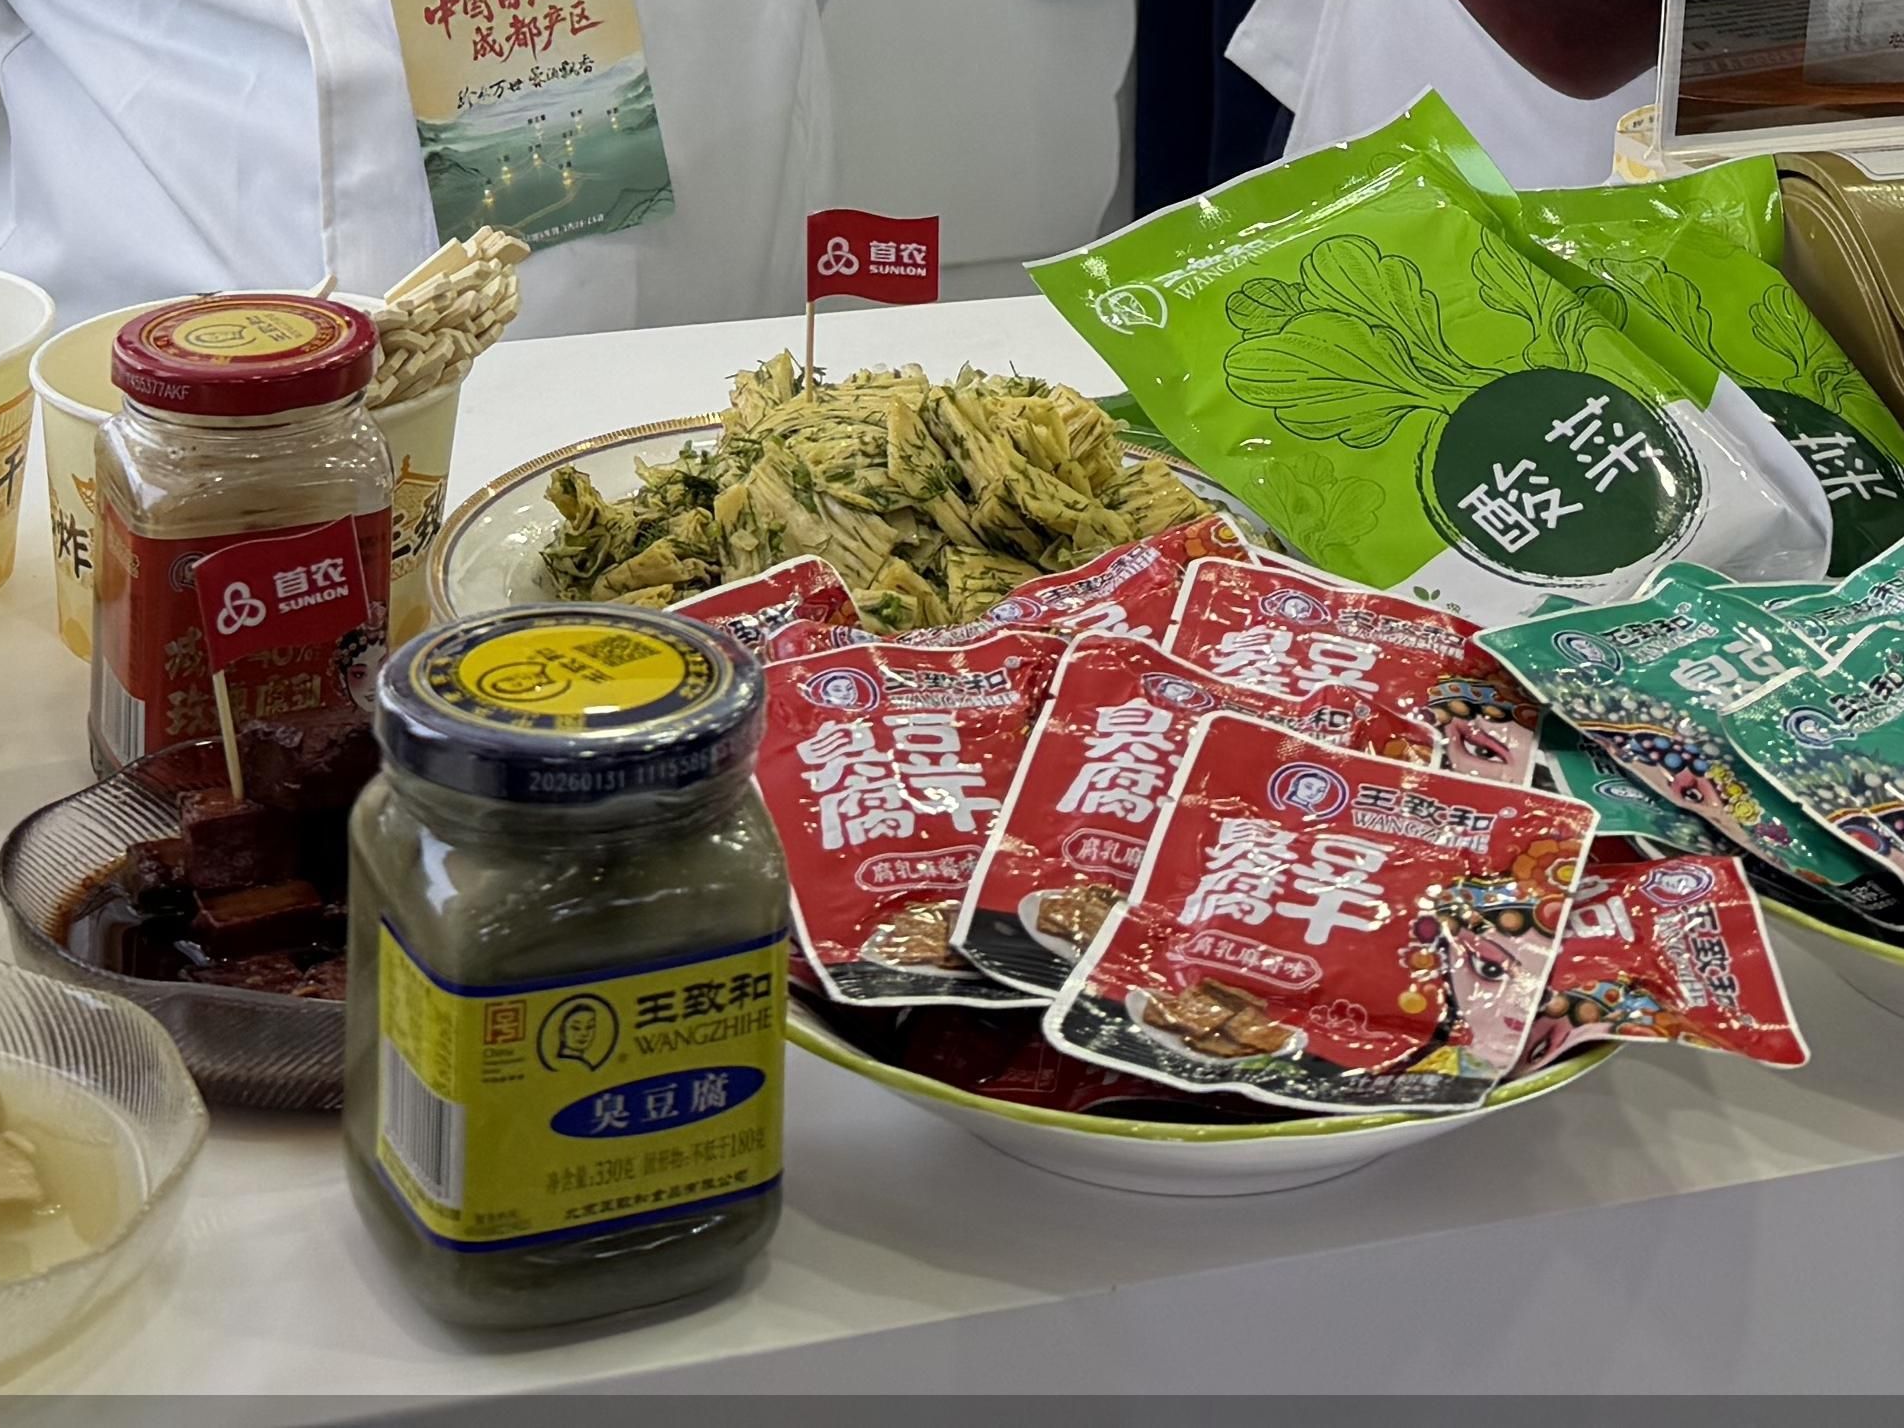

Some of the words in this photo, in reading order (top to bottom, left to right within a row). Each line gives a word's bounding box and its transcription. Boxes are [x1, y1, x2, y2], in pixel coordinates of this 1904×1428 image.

[472, 0, 606, 64] 成都产区
[868, 264, 927, 277] SUNLON
[869, 240, 927, 265] 首农
[1456, 392, 1665, 555] 酸菜
[51, 509, 95, 579] 炸
[272, 556, 348, 599] 首农
[277, 584, 350, 615] SUNLON
[529, 769, 627, 792] 20260131
[1353, 782, 1498, 832] 王致和
[634, 973, 774, 1029] 王致和
[633, 1005, 775, 1057] WANGZHIHE
[590, 1072, 731, 1134] 臭豆腐
